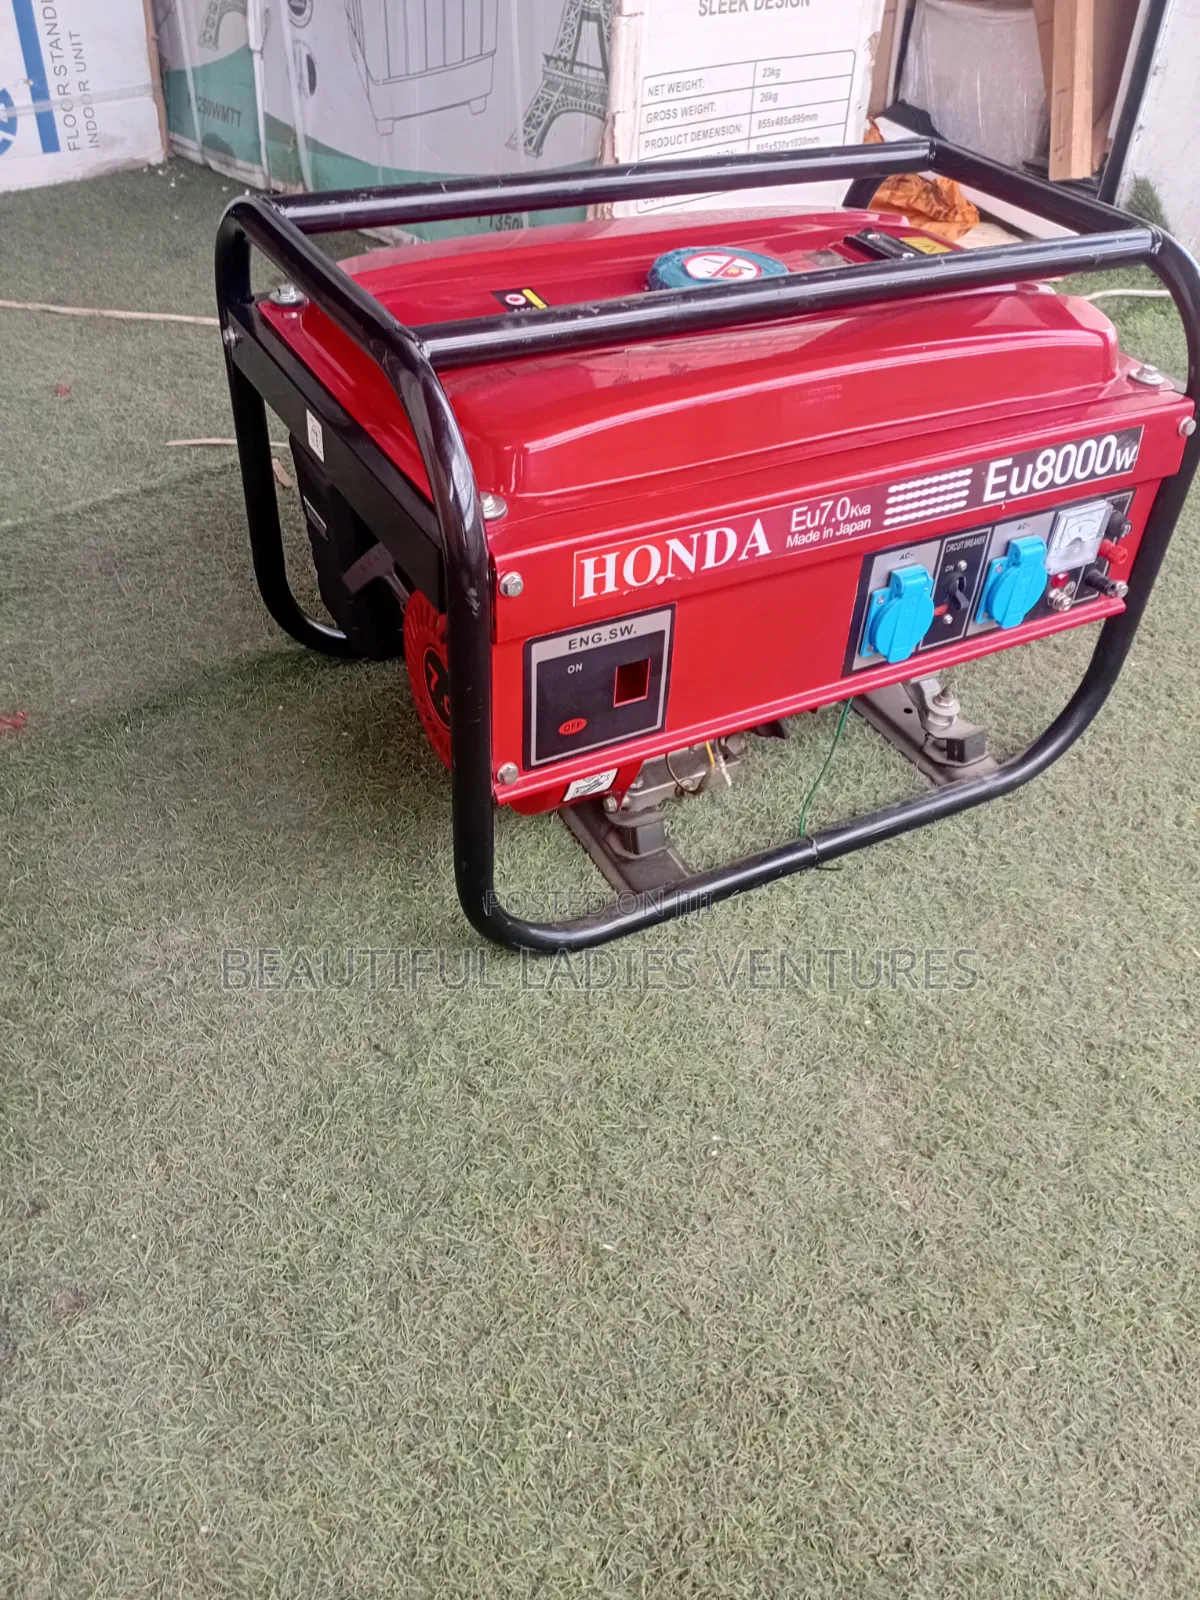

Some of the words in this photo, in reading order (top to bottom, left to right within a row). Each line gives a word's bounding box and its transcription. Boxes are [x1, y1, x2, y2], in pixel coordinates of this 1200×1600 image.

[698, 0, 750, 17] SLEEK
[69, 30, 87, 73] UNIT
[762, 66, 781, 79] 23kg
[647, 84, 666, 98] NET
[667, 78, 705, 94] WEIGHT:
[760, 91, 779, 103] 26kg
[57, 82, 81, 152] FLOOR
[78, 80, 100, 149] INDOOR
[646, 108, 678, 124] GROSS
[680, 101, 717, 118] WEIGHT:
[644, 132, 688, 151] PRODUCT
[690, 122, 744, 141] DEMENSION:
[786, 529, 820, 548] Made
[823, 526, 834, 540] in
[835, 518, 872, 536] Japan
[945, 541, 965, 553] CIRCUIT
[964, 535, 987, 549] BREAKER
[579, 518, 772, 600] HONDA
[945, 564, 955, 573] ON
[568, 623, 637, 651] ENG.SW.
[567, 662, 583, 675] ON
[563, 720, 583, 733] OFF
